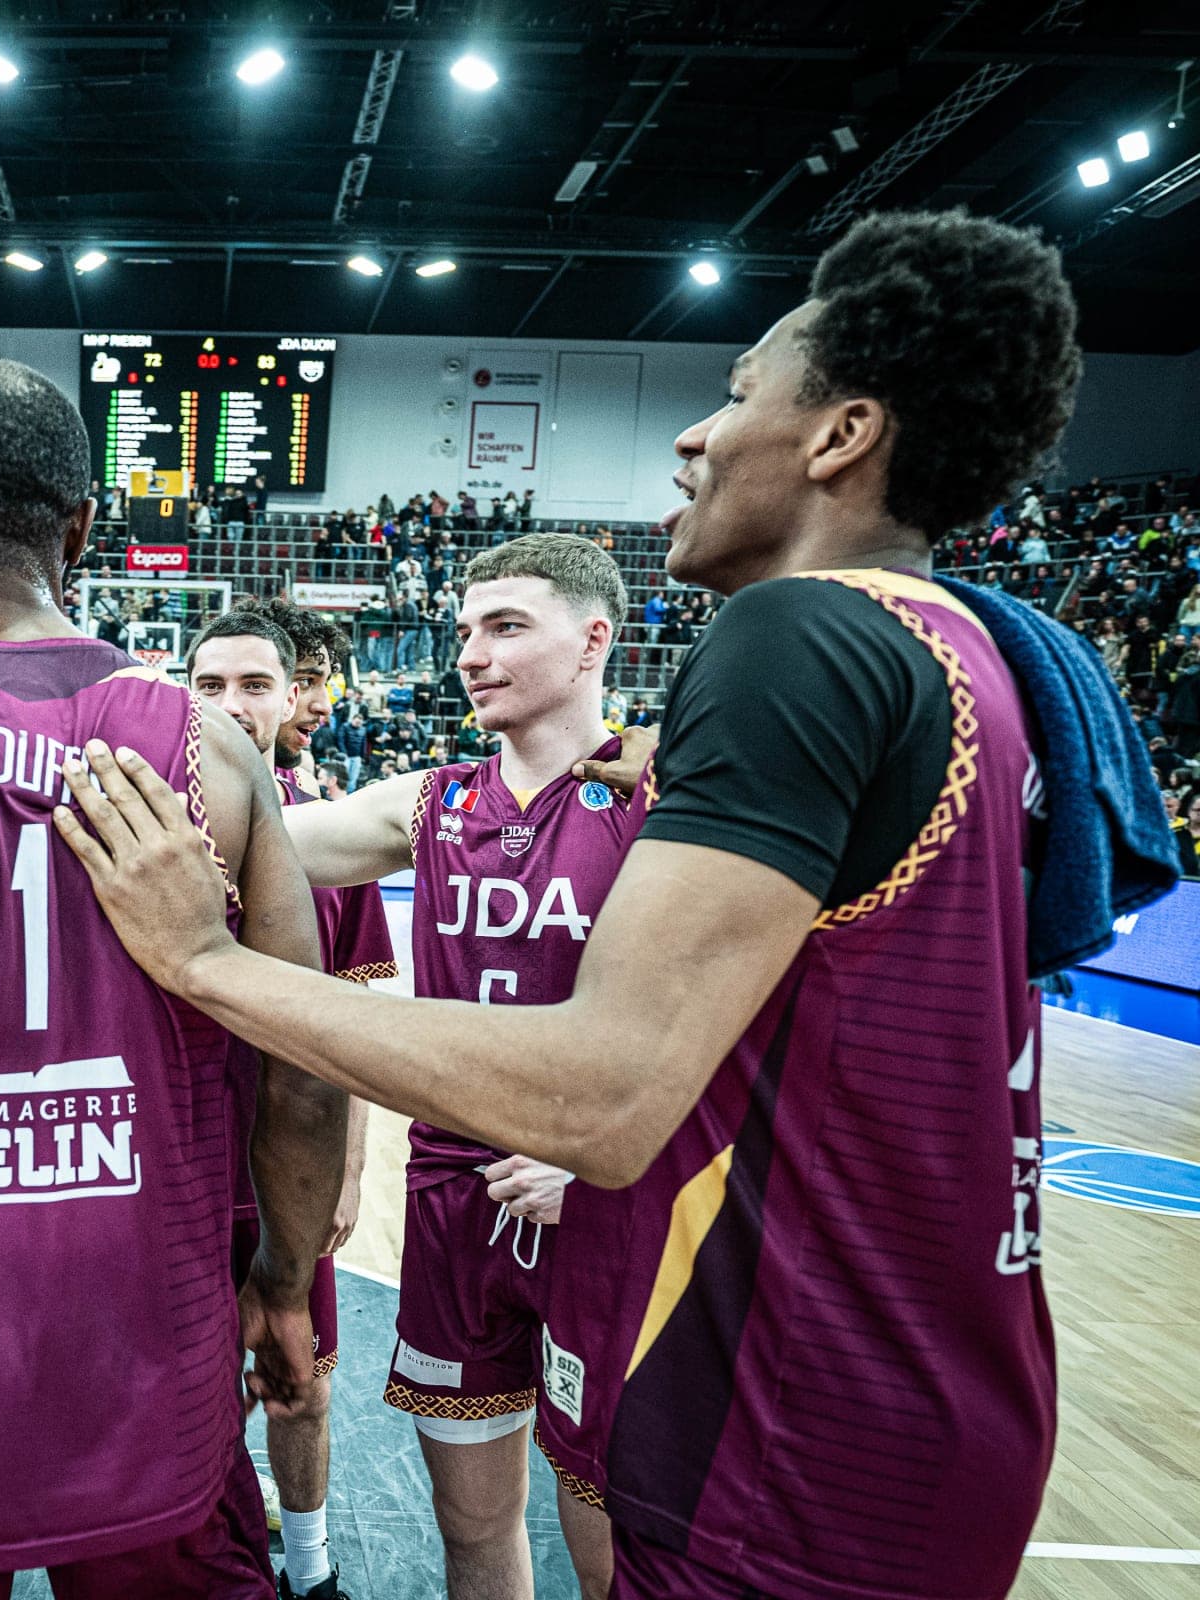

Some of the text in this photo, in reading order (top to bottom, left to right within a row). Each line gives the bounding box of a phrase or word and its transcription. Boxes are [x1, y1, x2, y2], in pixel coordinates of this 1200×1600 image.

[202, 337, 215, 351] 4
[144, 353, 162, 367] 72
[160, 499, 173, 517] 0
[131, 549, 183, 568] tipico
[436, 874, 592, 941] JDA
[11, 823, 49, 1031] 1
[403, 1351, 454, 1371] COLLECTION
